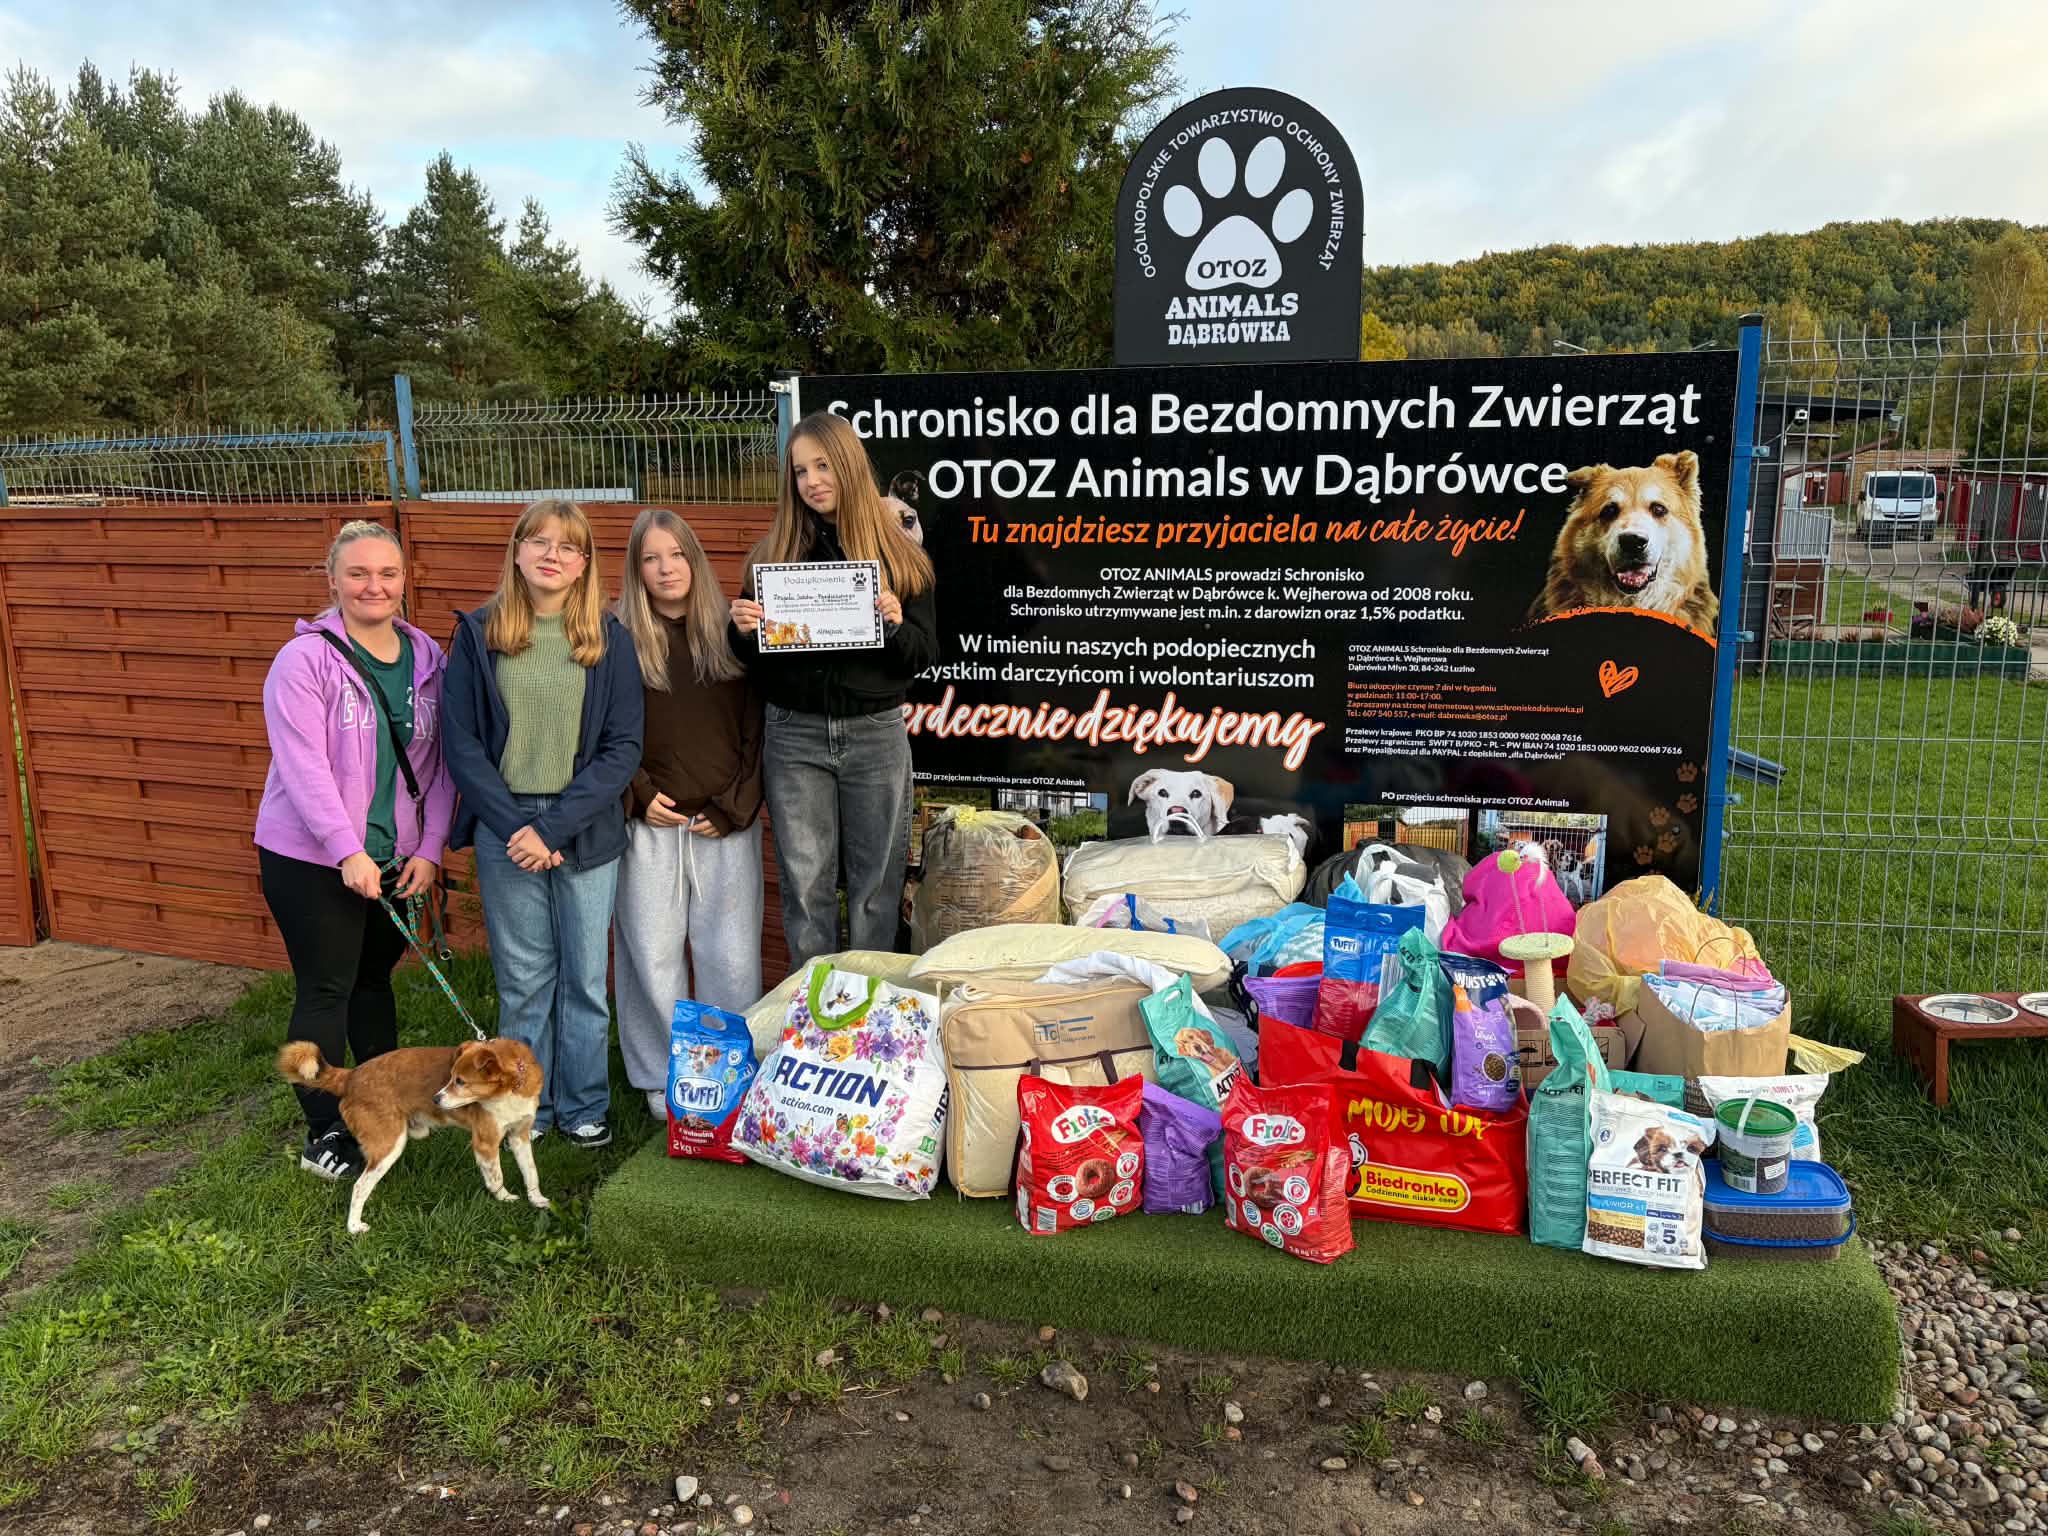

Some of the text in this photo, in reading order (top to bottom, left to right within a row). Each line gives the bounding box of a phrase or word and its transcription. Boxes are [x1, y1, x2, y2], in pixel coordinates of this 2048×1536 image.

[1134, 109, 1344, 278] OGÓLNOPOLSKIE TOWARZYSTWO OCHRONY ZWIERZĄT
[1198, 259, 1267, 279] OTOZ
[1165, 293, 1298, 319] ANIMALS
[1168, 318, 1290, 347] DĄBRÓWKA
[827, 384, 1701, 439] Schronisko dla Bezdomnych Zwierząt
[928, 452, 1568, 504] OTOZ Animals w Dąbrówce
[968, 508, 1525, 557] Tu znajdziesz przyjaciela na całe życie!
[1100, 568, 1365, 585] OTOZ ANIMALS prowadzi Schronisko
[1004, 586, 1474, 602] dla Bezdomnych Zwierząt w Dąbrówce k. Wejherowa od 2008 roku.
[1010, 604, 1465, 622] Schronisko utrzymywane jest m.in. z darowizn oraz 1,5% podatku.
[960, 634, 1316, 661] W imieniu naszych podopiecznych
[1349, 645, 1549, 656] OTOZ ANIMALS Schronisko dla Bezdomnych Zwierząt
[1348, 664, 1386, 672] Dąbrówka
[1388, 665, 1407, 673] Młyn
[1409, 665, 1420, 673] 30,
[1357, 655, 1394, 663] Dąbrówce
[1404, 655, 1447, 664] Wejherowa
[914, 662, 1314, 687] zystkim darczyńcom i wolontariuszom
[1348, 682, 1368, 690] Biuro
[901, 685, 1325, 770] erdecznie dziękujemy
[1346, 728, 1380, 736] Przelewy
[1381, 729, 1412, 738] krajowe:
[1562, 734, 1582, 742] 7616
[1346, 737, 1379, 745] Przelewy
[1380, 738, 1426, 747] zagraniczne:
[1429, 739, 1454, 747] SWIFT
[1455, 740, 1481, 748] B/PKO
[1507, 741, 1521, 749] PW
[1468, 750, 1507, 758] dopiskiem
[973, 775, 1011, 783] schroniska
[1056, 778, 1085, 786] Animals
[1382, 792, 1569, 807] PO przejęciu schroniska przez OTOZ Animals
[772, 1055, 888, 1107] ACTION
[781, 1095, 834, 1116] action.com
[1251, 1119, 1299, 1140] Frolc
[1366, 1171, 1458, 1197] Biedronka
[1658, 1178, 1681, 1192] FIT
[1663, 1229, 1676, 1244] 5
